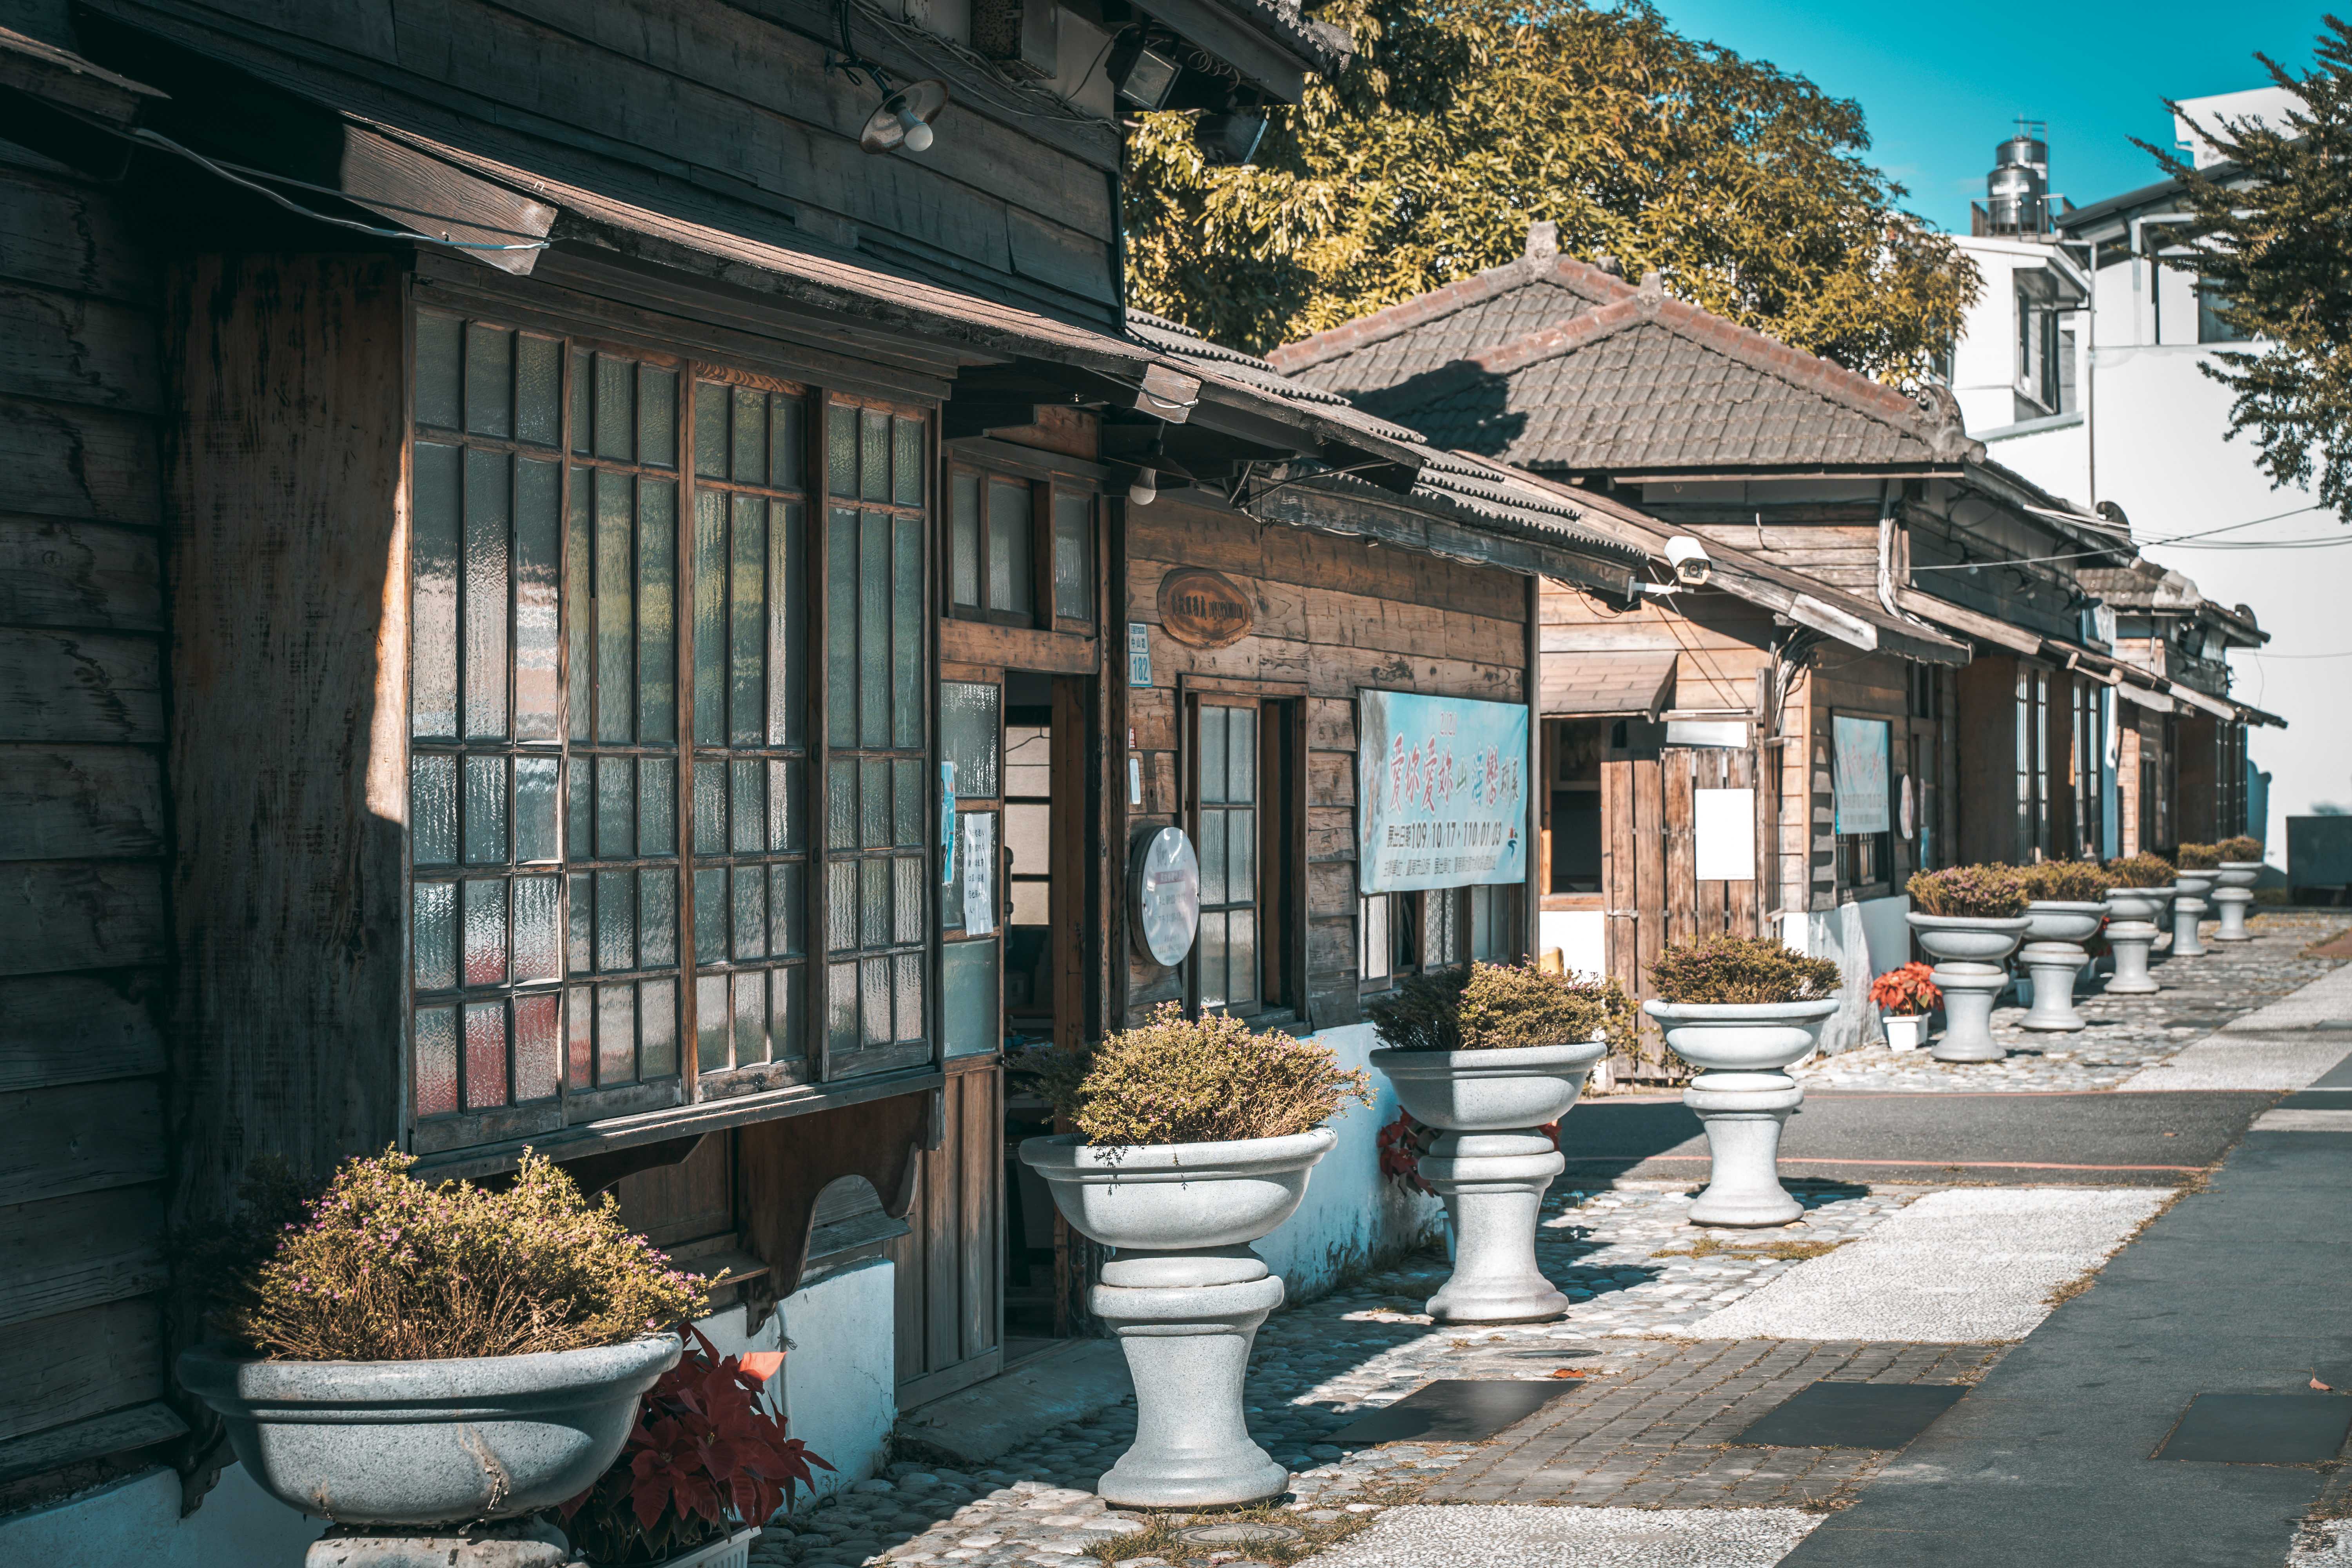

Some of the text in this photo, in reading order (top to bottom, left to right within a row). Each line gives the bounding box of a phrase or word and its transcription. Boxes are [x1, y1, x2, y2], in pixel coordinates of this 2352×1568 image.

[1131, 637, 1146, 649] 中山路
[1133, 657, 1148, 681] 182
[1440, 711, 1457, 737] 2020
